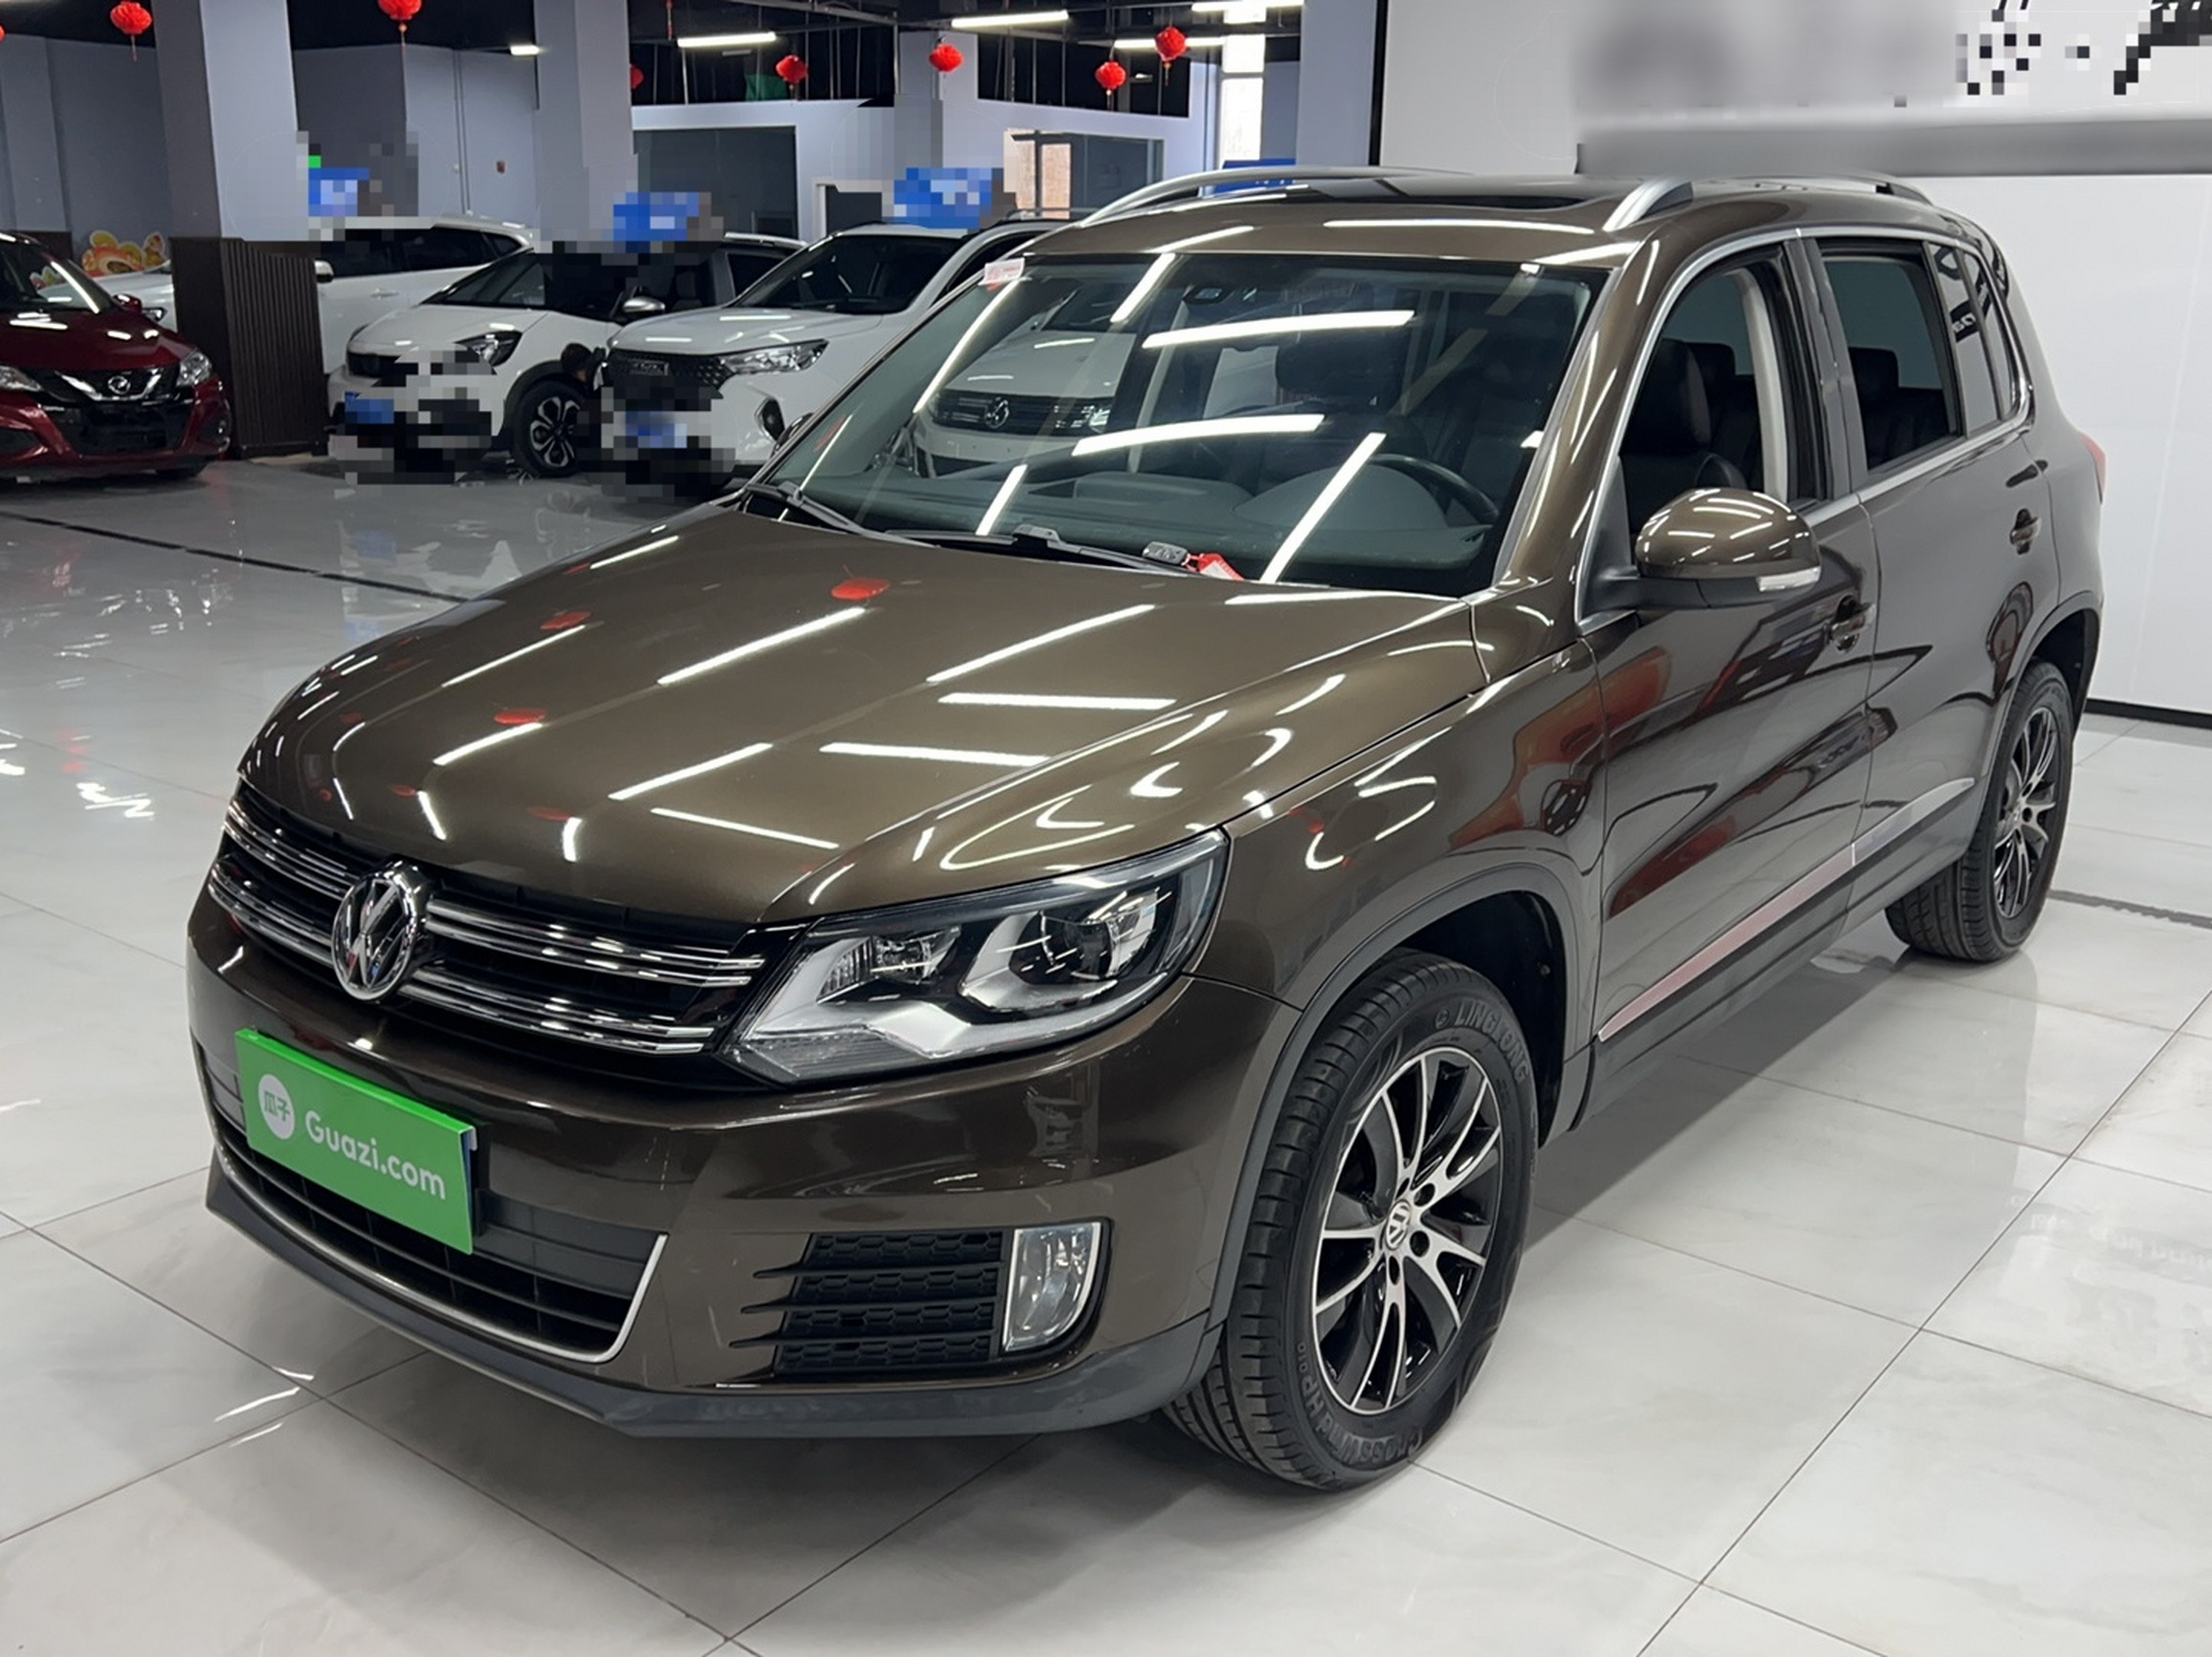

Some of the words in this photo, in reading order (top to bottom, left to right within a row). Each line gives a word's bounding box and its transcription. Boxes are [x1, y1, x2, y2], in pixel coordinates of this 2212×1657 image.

[1454, 997, 1529, 1083] LINGLONG
[264, 1090, 291, 1122] 瓜子
[305, 1110, 446, 1201] Guazi.com
